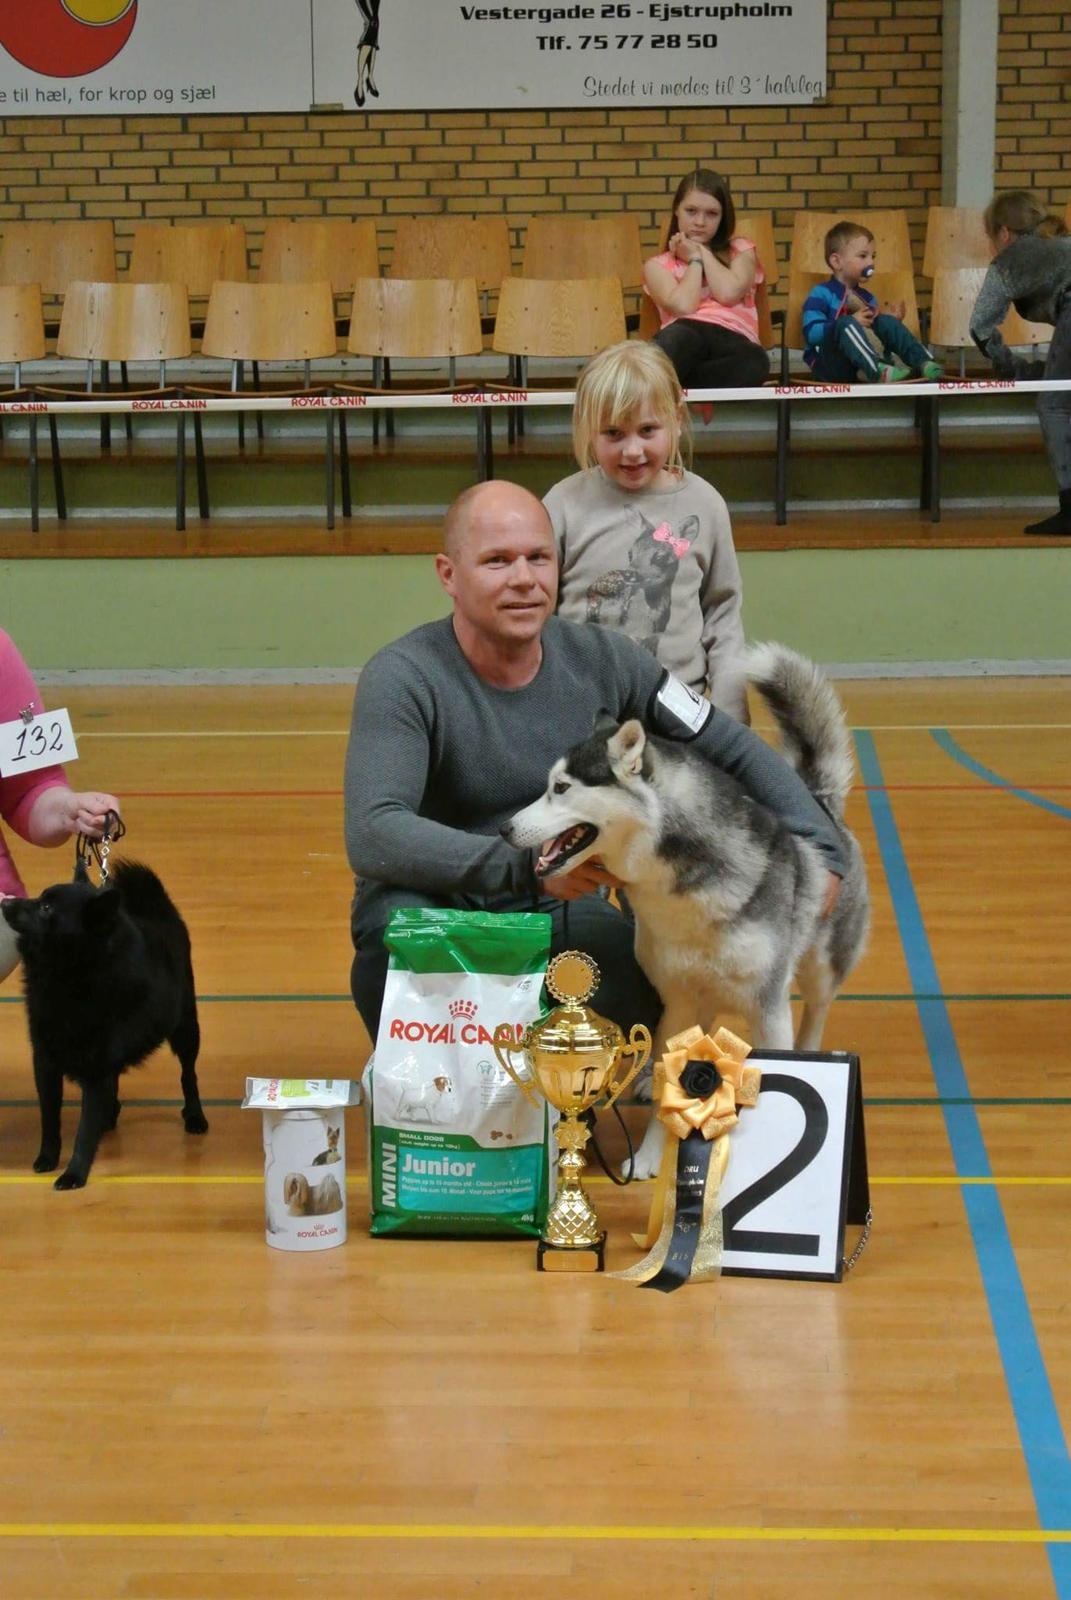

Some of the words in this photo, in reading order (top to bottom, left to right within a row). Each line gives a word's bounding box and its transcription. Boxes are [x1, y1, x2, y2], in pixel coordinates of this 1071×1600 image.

[460, 5, 595, 23] Vestergade
[600, 4, 631, 19] 26
[649, 2, 793, 21] Ejstrupholm
[536, 36, 572, 51] Tlf.
[578, 35, 608, 50] 75
[615, 35, 644, 49] 77
[650, 34, 681, 49] 28
[687, 34, 718, 48] 50
[13, 89, 29, 102] til
[36, 89, 72, 104] hæl,
[80, 87, 103, 101] for
[109, 87, 147, 103] krop
[153, 89, 174, 103] og
[180, 85, 216, 103] sjæl
[583, 76, 636, 97] Stedet
[642, 80, 653, 96] vi
[660, 76, 709, 96] mødes
[715, 75, 733, 95] til
[764, 74, 823, 98] halvleg
[11, 403, 48, 412] CANIN
[132, 401, 167, 410] ROYAL
[170, 400, 207, 409] CANIN
[291, 398, 326, 407] ROYAL
[329, 396, 366, 405] CANIN
[452, 394, 487, 403] ROYAL
[490, 392, 527, 402] CANIN
[12, 722, 63, 761] 132
[390, 1018, 457, 1044] ROYAL
[382, 1142, 397, 1208] MINI
[402, 1153, 476, 1177] Junior
[722, 1073, 828, 1256] 2
